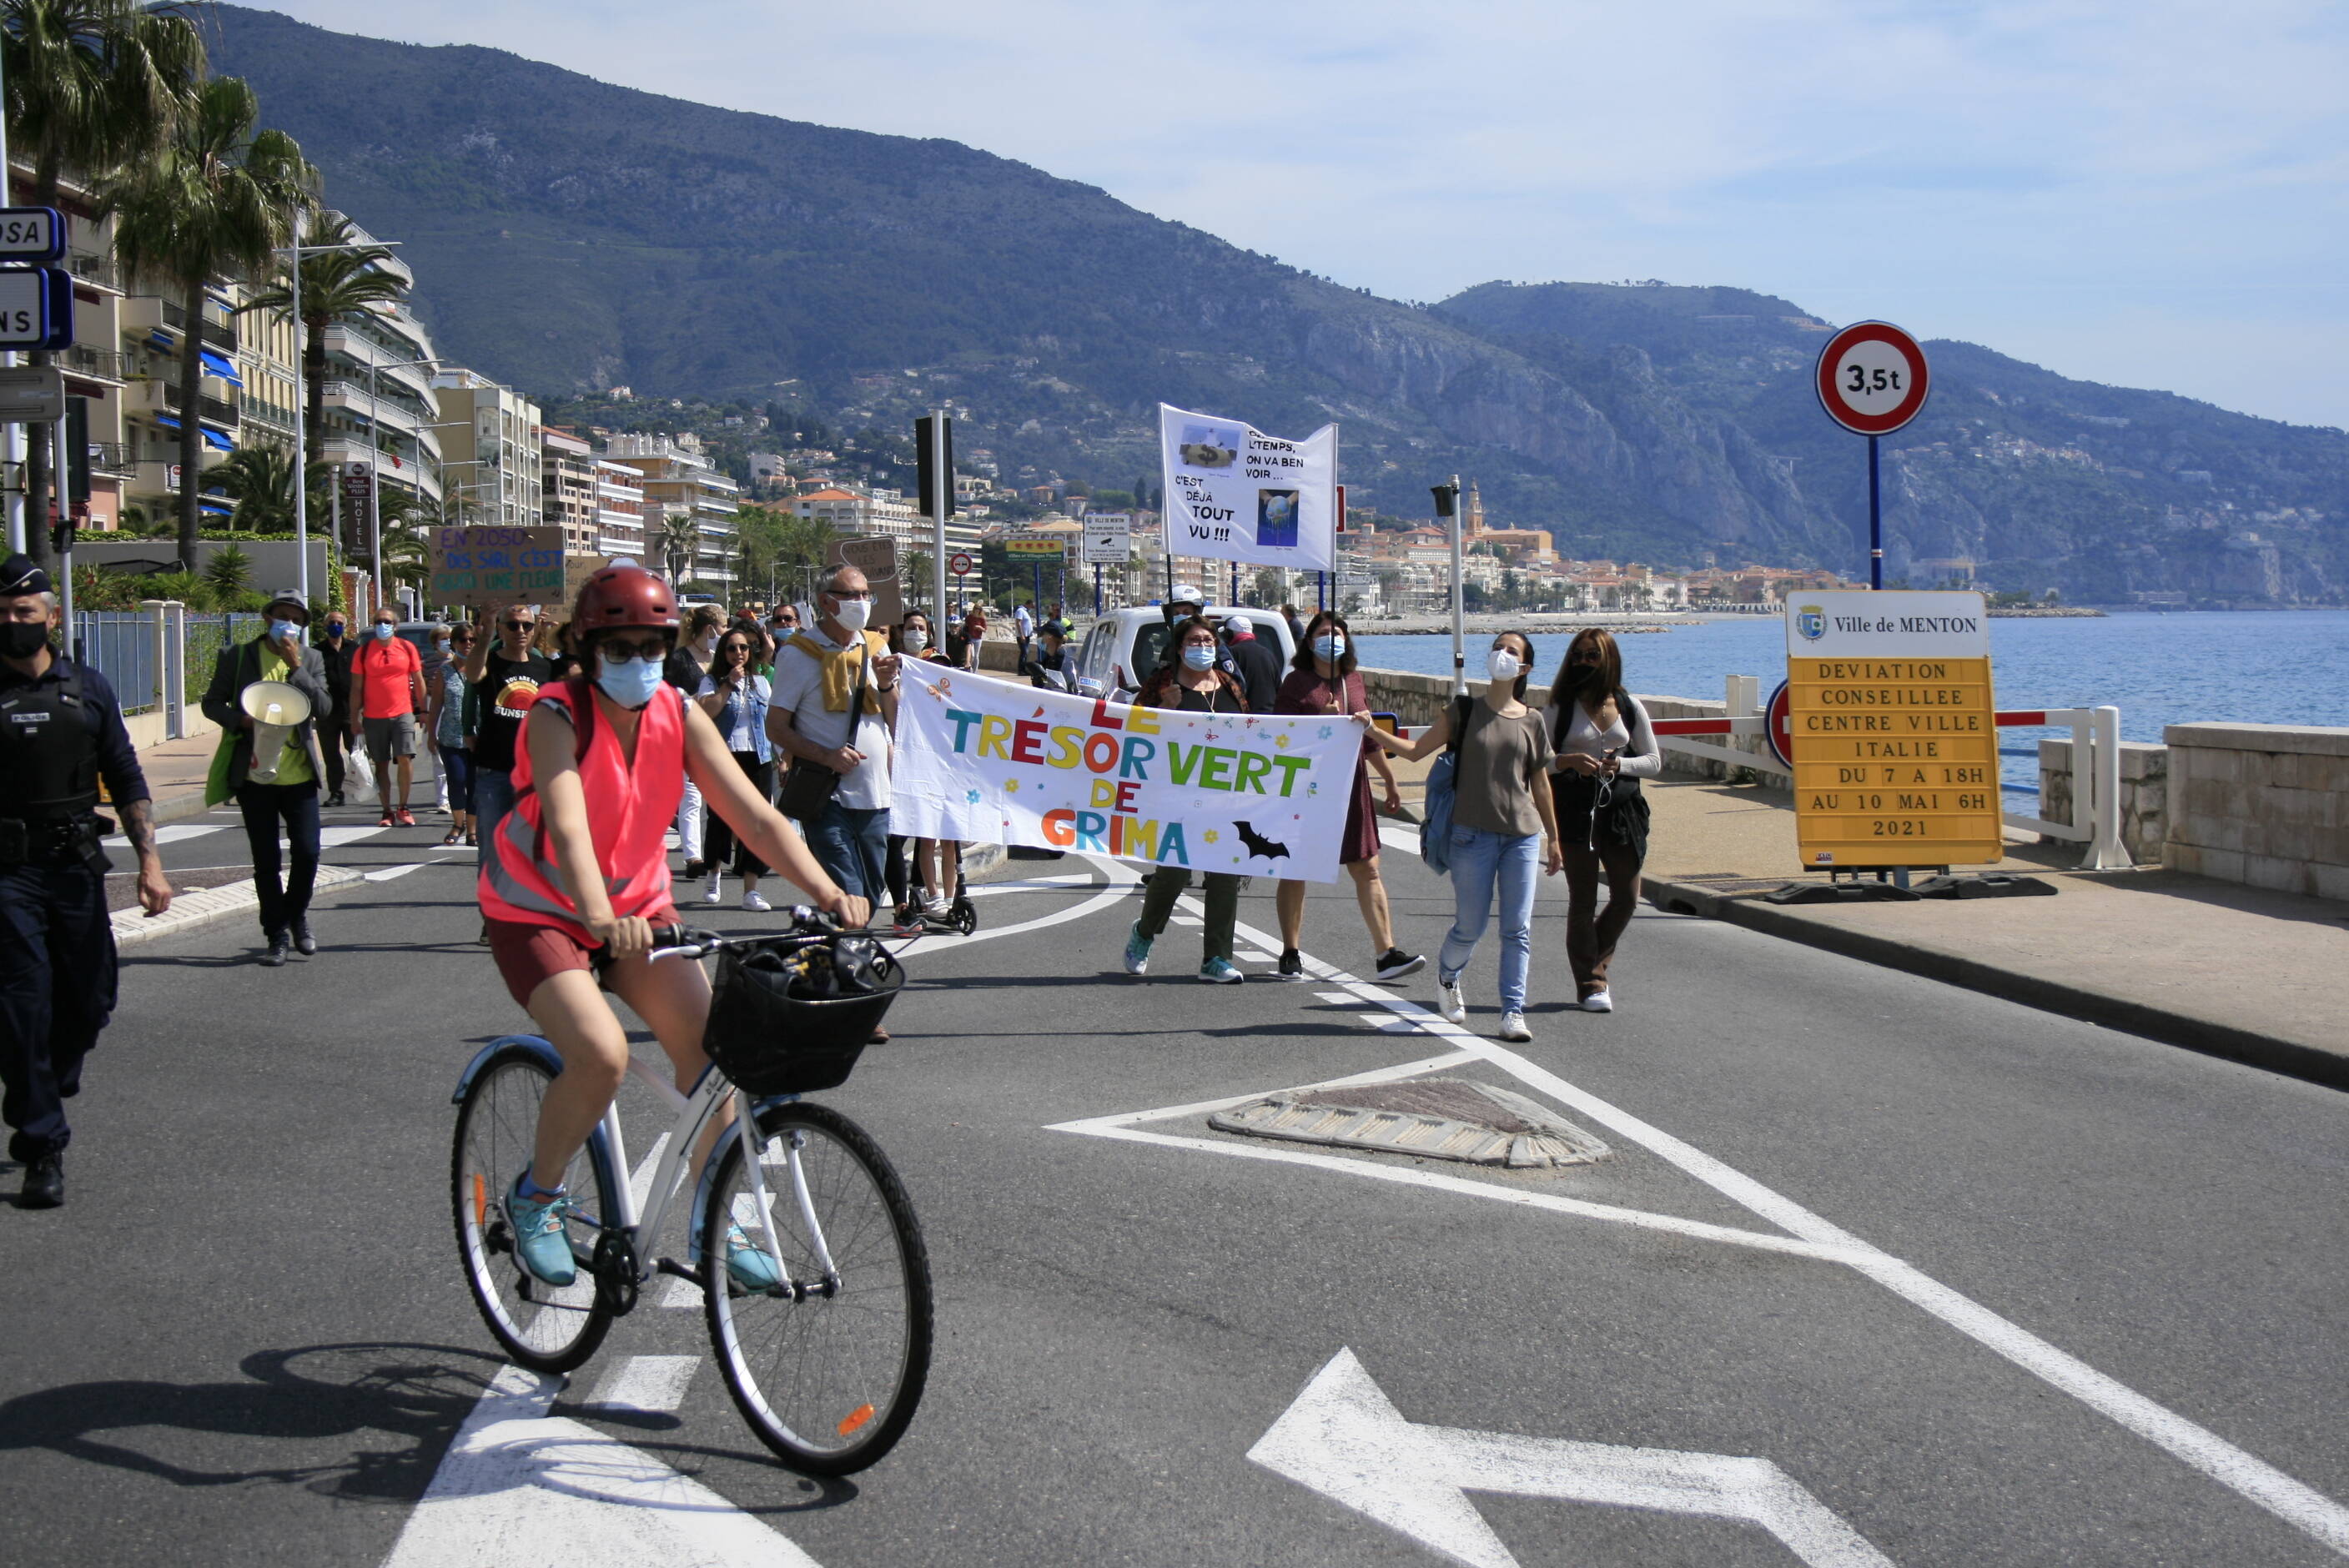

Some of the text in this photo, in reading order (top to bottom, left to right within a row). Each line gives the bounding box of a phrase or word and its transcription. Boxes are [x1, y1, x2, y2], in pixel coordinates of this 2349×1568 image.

[0, 222, 39, 244] SA
[1847, 364, 1901, 395] 3,5t
[1249, 440, 1295, 454] L'TEMPS,
[1247, 455, 1304, 468] ON VA BEN
[1175, 475, 1204, 487] C'EST
[1245, 469, 1270, 479] VOIR
[1186, 490, 1213, 502] DÉJÀ
[1192, 505, 1235, 521] TOUT
[355, 500, 363, 545] HOTEL
[441, 529, 467, 548] EN
[1190, 525, 1210, 539] VU
[1834, 617, 1977, 633] Ville de MENTON
[1818, 664, 1946, 679] DEVIATION
[1822, 690, 1963, 705] CONSEILLEE
[1090, 699, 1161, 735] LE
[1807, 716, 1979, 731] CENTRE VILLE
[946, 707, 1311, 798] TRÉSOR VERT
[1855, 742, 1938, 756] ITALIE
[1839, 768, 1984, 782] DU 7 A 18H
[1089, 779, 1142, 813] DE
[1812, 794, 1985, 809] AU 10 MAI 6H
[1874, 821, 1926, 835] 2021
[1041, 808, 1190, 866] GRIMA
